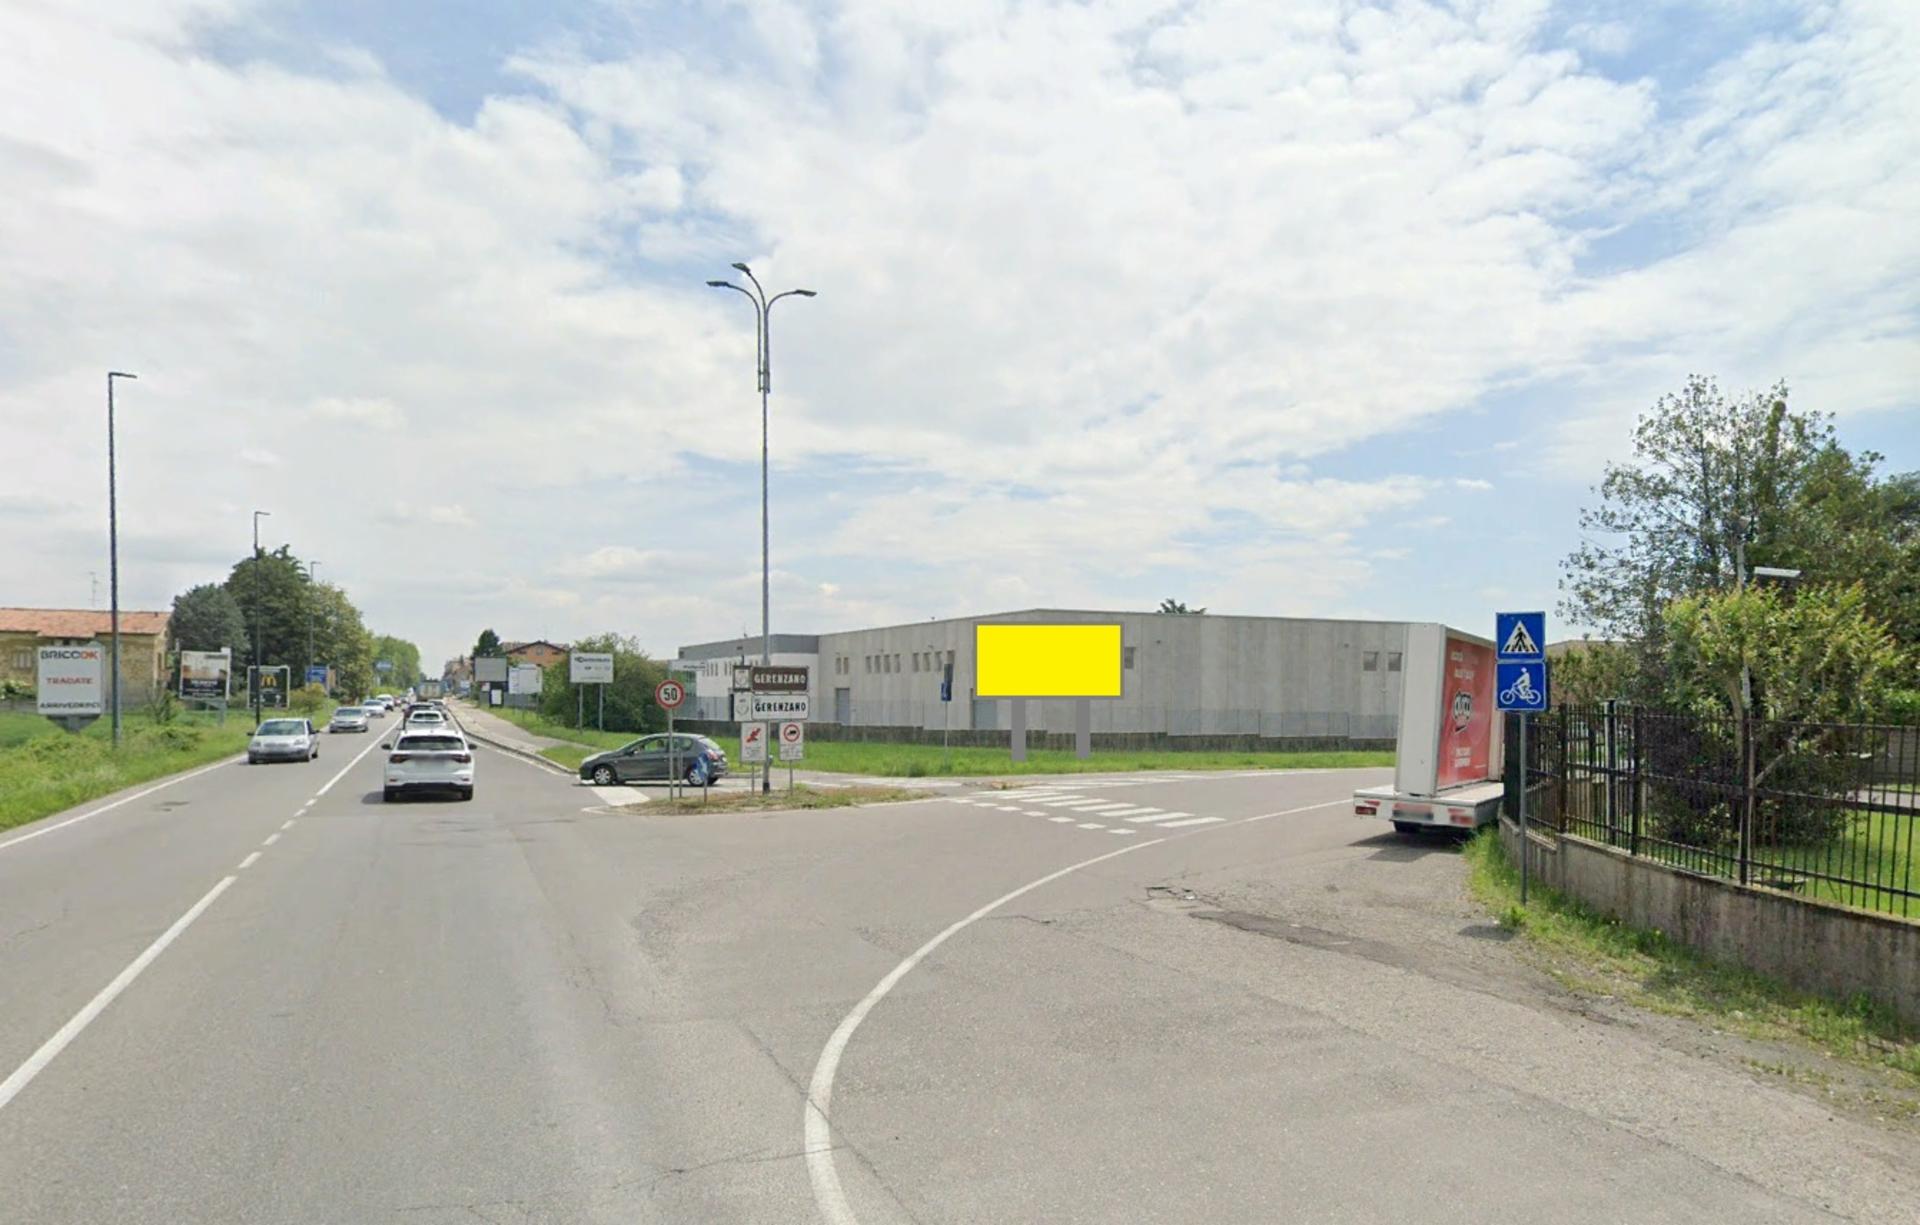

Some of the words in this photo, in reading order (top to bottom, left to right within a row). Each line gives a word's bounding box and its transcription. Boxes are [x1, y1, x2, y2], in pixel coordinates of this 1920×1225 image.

[754, 673, 806, 684] GERENZANO
[663, 687, 678, 701] 50
[755, 702, 806, 712] GERENZANO
